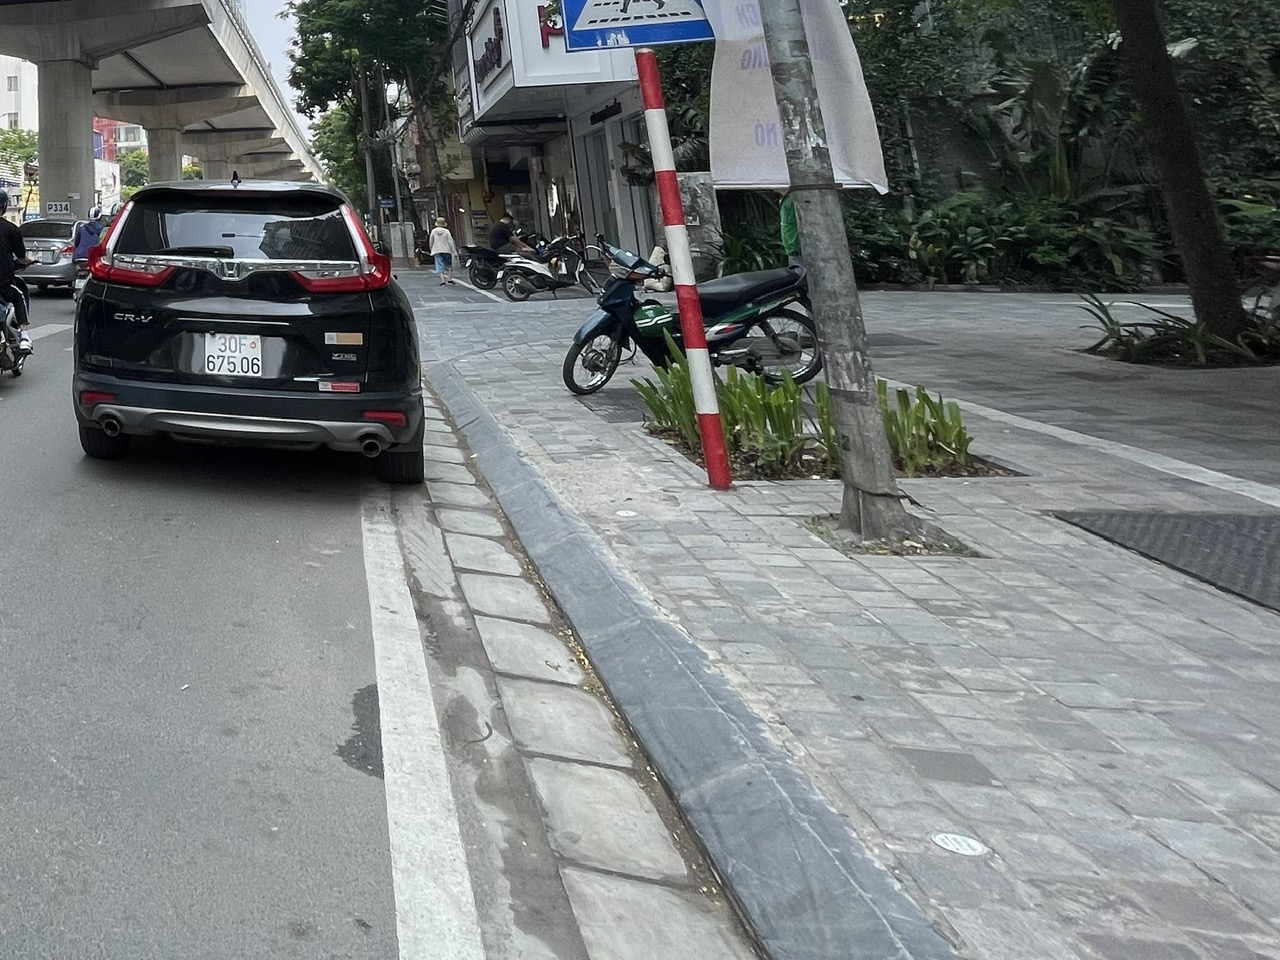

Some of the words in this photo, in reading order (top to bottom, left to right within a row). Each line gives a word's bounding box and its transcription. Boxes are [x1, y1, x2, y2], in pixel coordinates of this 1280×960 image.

[47, 202, 69, 212] P334
[113, 313, 153, 323] CR-V
[218, 336, 247, 354] 30F
[206, 355, 260, 375] 675.06
